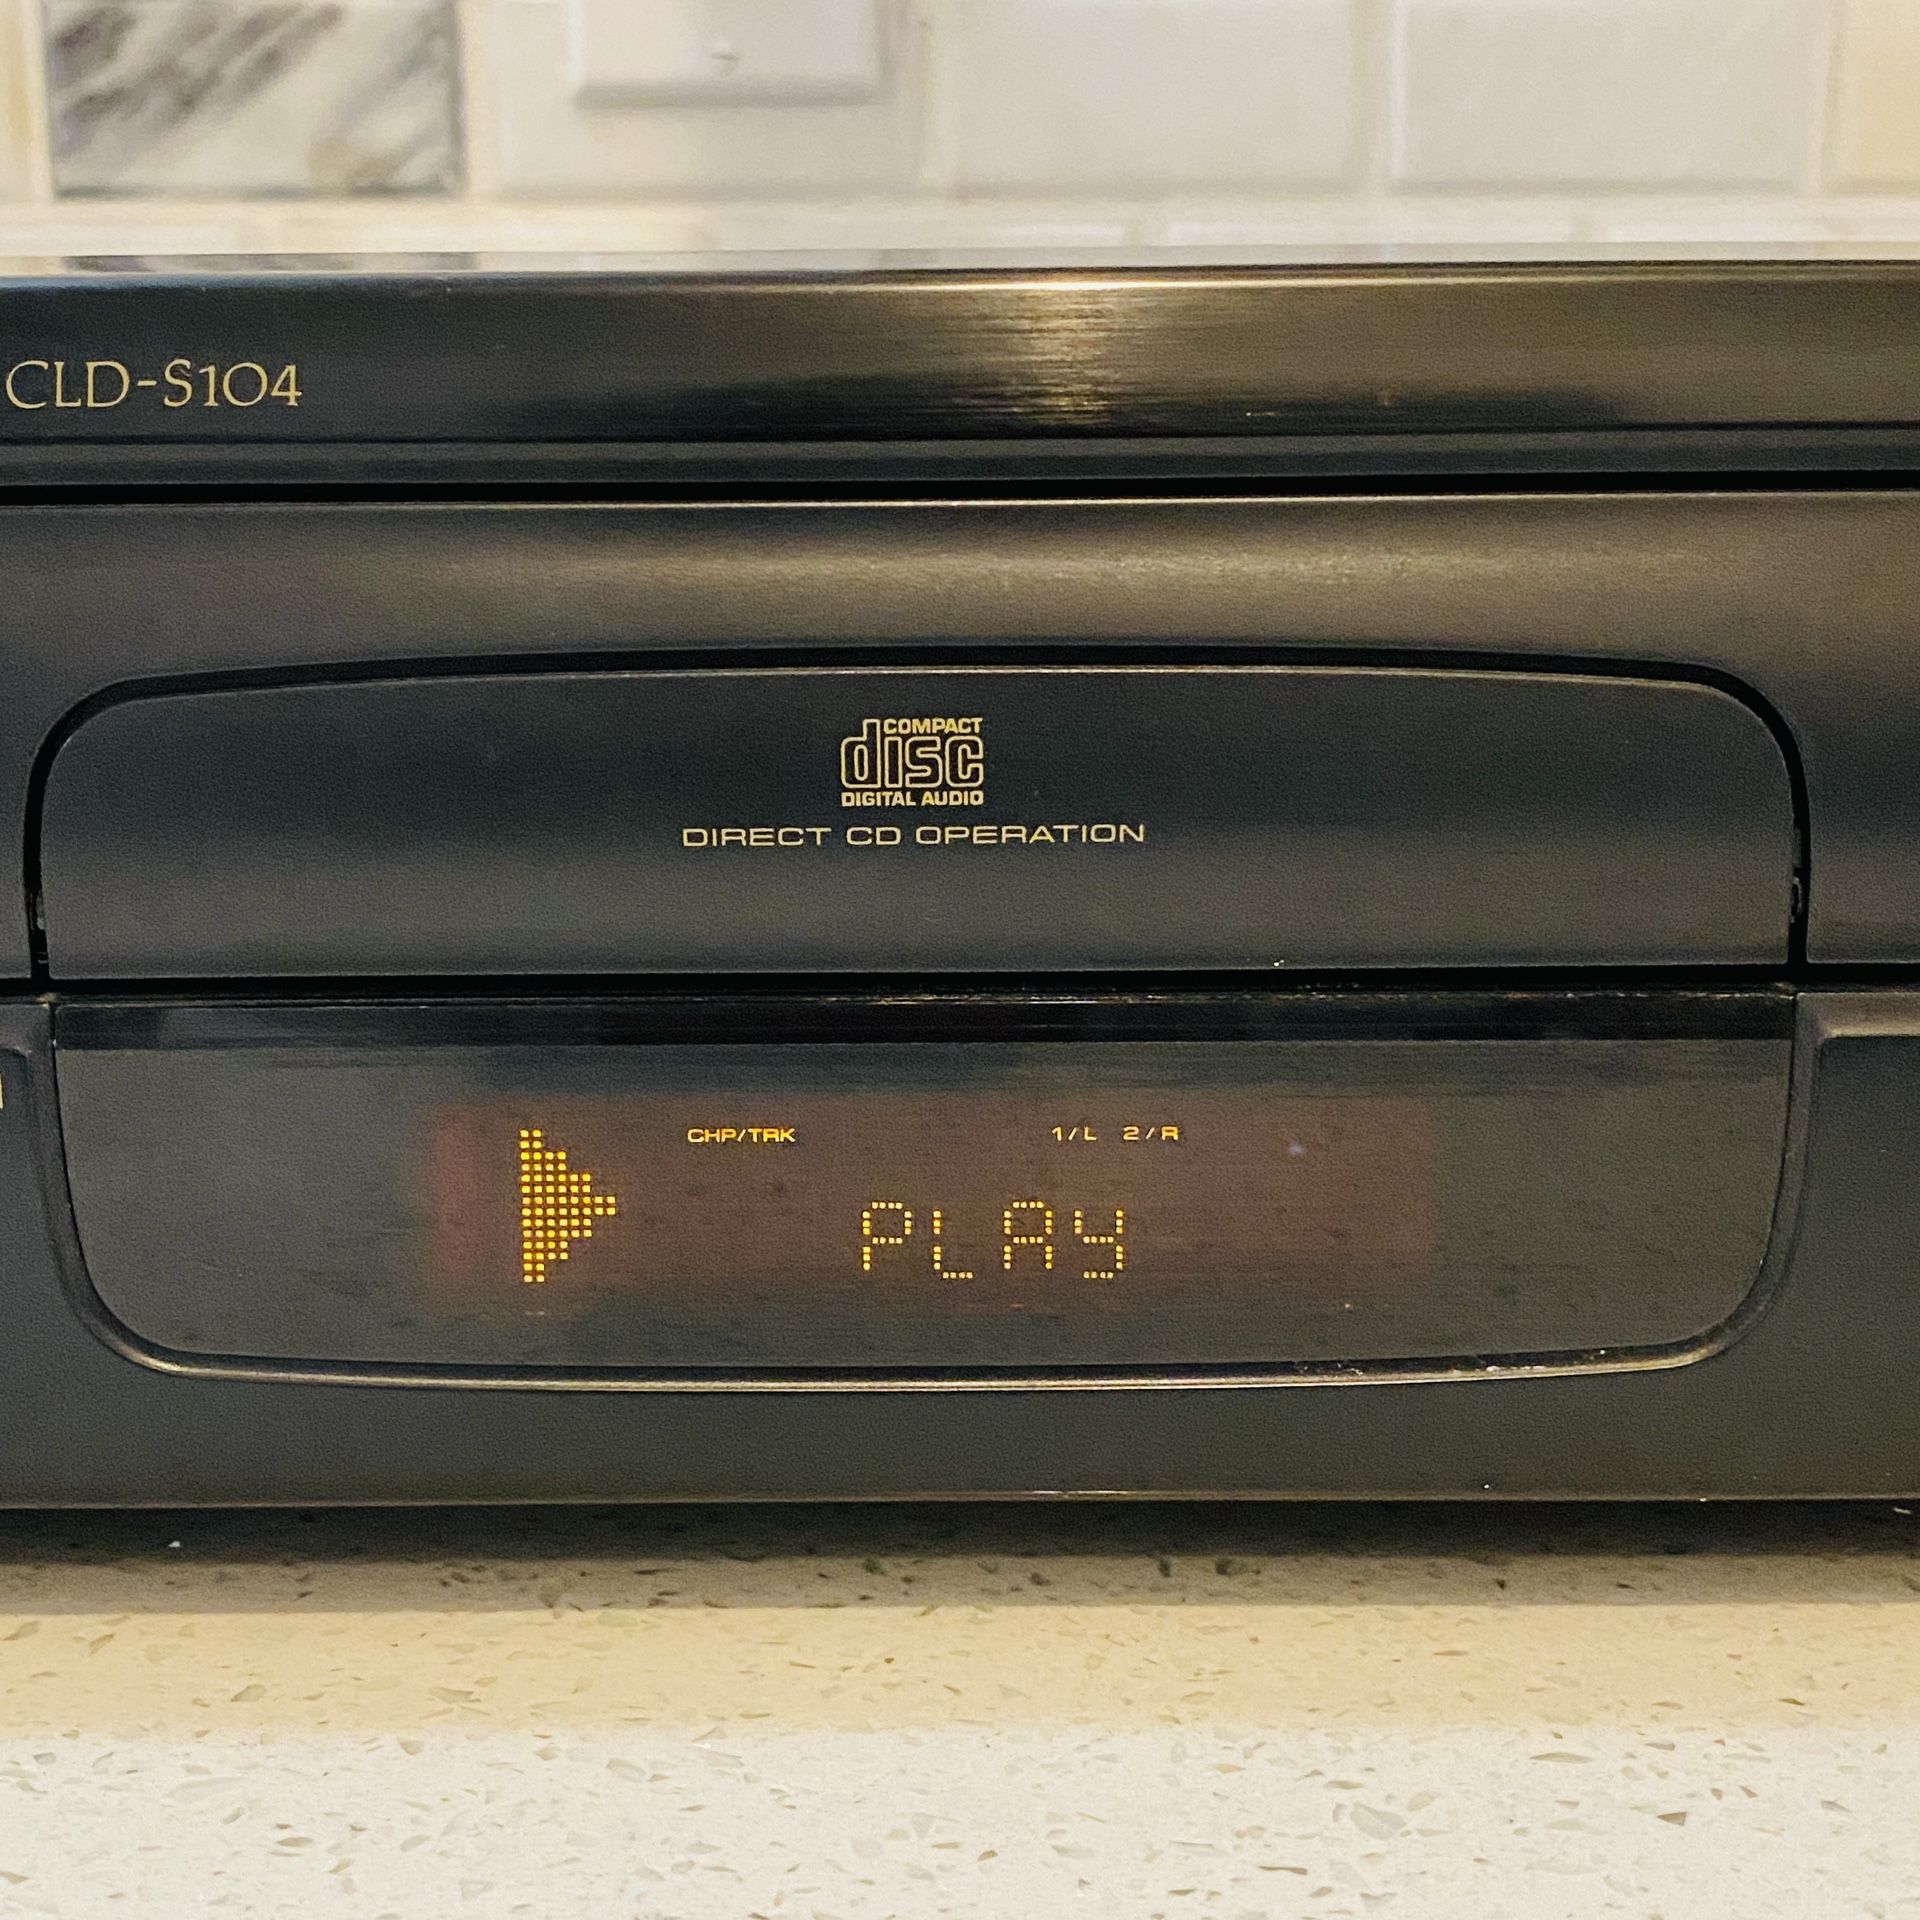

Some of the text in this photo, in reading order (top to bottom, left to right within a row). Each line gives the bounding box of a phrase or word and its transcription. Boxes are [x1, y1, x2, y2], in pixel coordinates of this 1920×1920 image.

[5, 358, 303, 409] CLD-S104
[883, 717, 984, 735] COMPACT
[840, 718, 985, 788] disc
[841, 790, 985, 807] DIGITAL AUDIO
[682, 823, 1145, 847] DIRECT CD OPERATION
[687, 1127, 796, 1143] CHP/TRK
[1051, 1125, 1179, 1141] 1/L 2/R
[861, 1201, 1125, 1279] PLAY
